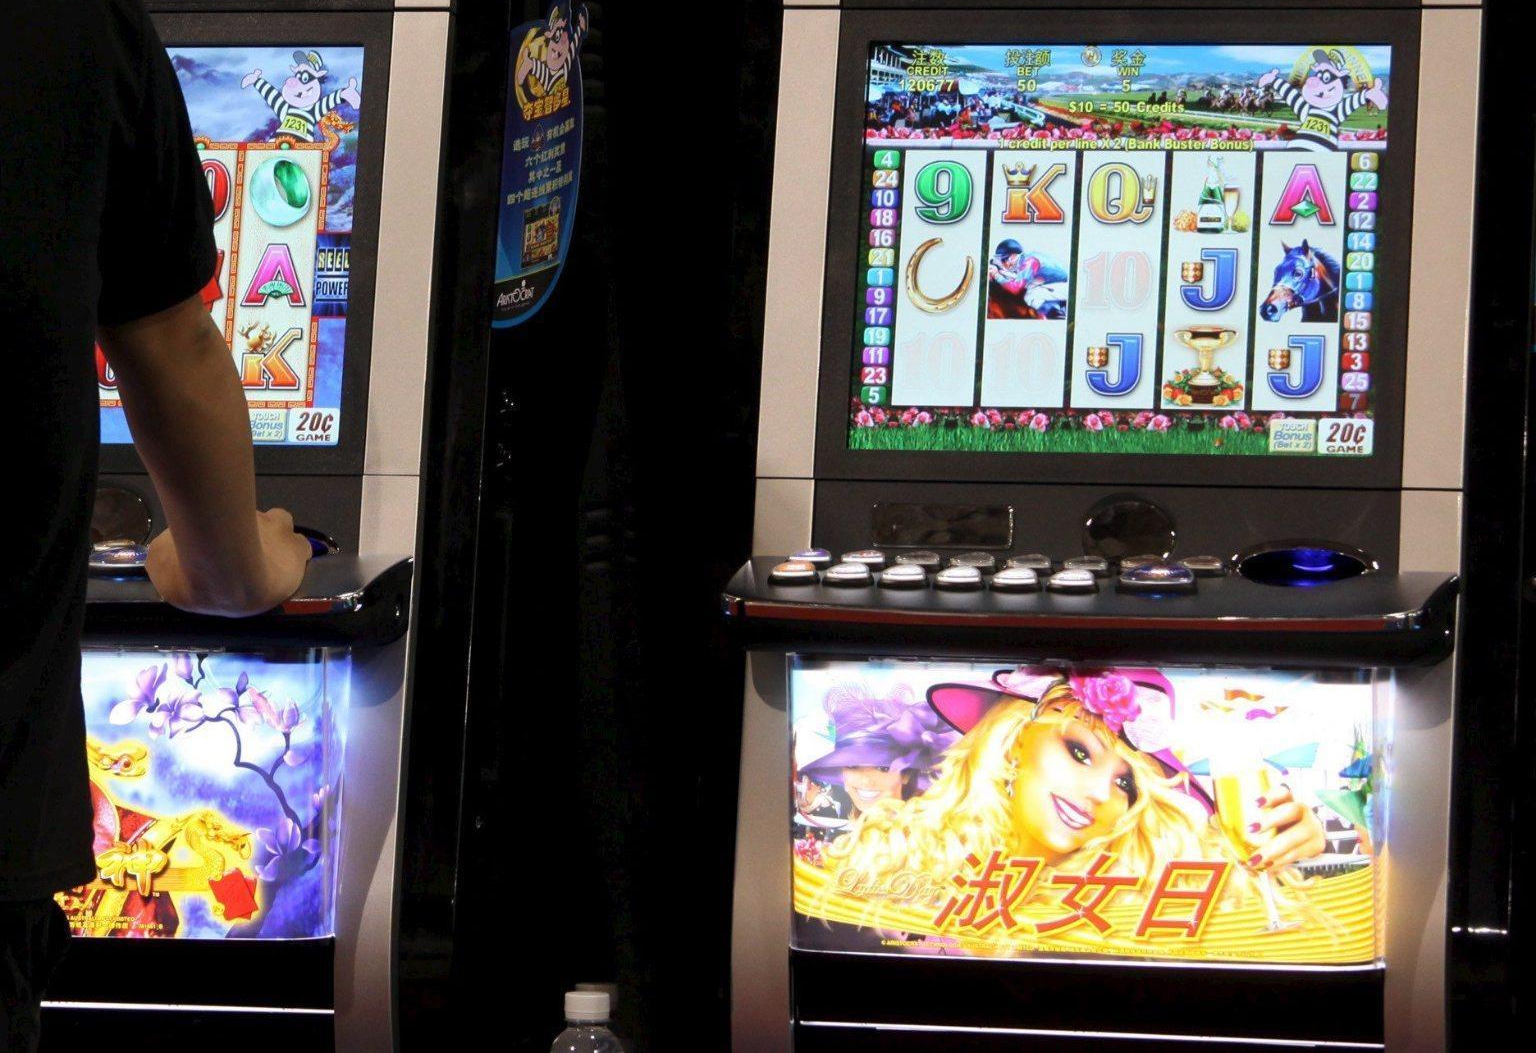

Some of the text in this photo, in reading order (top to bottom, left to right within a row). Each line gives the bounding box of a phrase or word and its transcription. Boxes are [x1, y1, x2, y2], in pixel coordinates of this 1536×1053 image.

[911, 49, 947, 67] 注数
[1005, 49, 1051, 67] 投注额
[1111, 49, 1147, 67] 奖金
[907, 66, 948, 76] CREDIT
[1017, 66, 1040, 76] BET
[1117, 66, 1140, 76] WIN
[898, 79, 954, 93] 120677
[1017, 79, 1037, 92] 50
[1122, 80, 1131, 92] 5
[1069, 101, 1093, 113] $10
[1114, 101, 1130, 113] 50
[1137, 101, 1185, 113] Credits
[284, 116, 309, 134] 1231
[1306, 118, 1330, 135] 1231
[1009, 137, 1047, 149] credit
[1050, 139, 1072, 152] per
[1075, 137, 1097, 149] line
[1114, 138, 1122, 149] 2
[1124, 138, 1161, 152] (Bank
[1165, 138, 1208, 150] Buster
[1212, 138, 1255, 152] Bonus)
[881, 151, 893, 167] 4
[1359, 153, 1370, 170] 6
[875, 170, 898, 188] 24
[1354, 173, 1377, 190] 22
[876, 189, 895, 207] 10
[914, 160, 974, 225] 9
[1001, 160, 1068, 225] K
[1088, 162, 1154, 225] Q
[1269, 163, 1336, 227] A
[1357, 193, 1369, 209] 2
[875, 209, 893, 227] 18
[1352, 212, 1372, 230] 12
[874, 229, 892, 247] 16
[1352, 232, 1371, 250] 14
[872, 249, 892, 266] 21
[1350, 253, 1371, 270] 20
[241, 243, 306, 308] A
[1081, 250, 1151, 313] 10
[1180, 247, 1239, 312] J
[874, 288, 885, 305] 9
[1352, 293, 1364, 310] 8
[869, 307, 887, 325] 17
[1349, 312, 1368, 330] 15
[868, 328, 887, 345] 19
[1348, 333, 1367, 351] 13
[241, 328, 303, 390] K
[869, 347, 883, 364] 11
[1085, 332, 1144, 397] J
[1350, 353, 1363, 370] 3
[863, 367, 887, 384] 23
[1266, 334, 1326, 399] J
[1345, 374, 1368, 392] 25
[868, 387, 880, 404] 5
[1349, 393, 1360, 410] 7
[296, 412, 334, 433] 20¢
[296, 434, 331, 442] GAME
[1273, 431, 1312, 441] Bonus
[1326, 422, 1367, 445] 20¢
[1274, 441, 1293, 449] (Bet
[933, 849, 1230, 939] 淑女日
